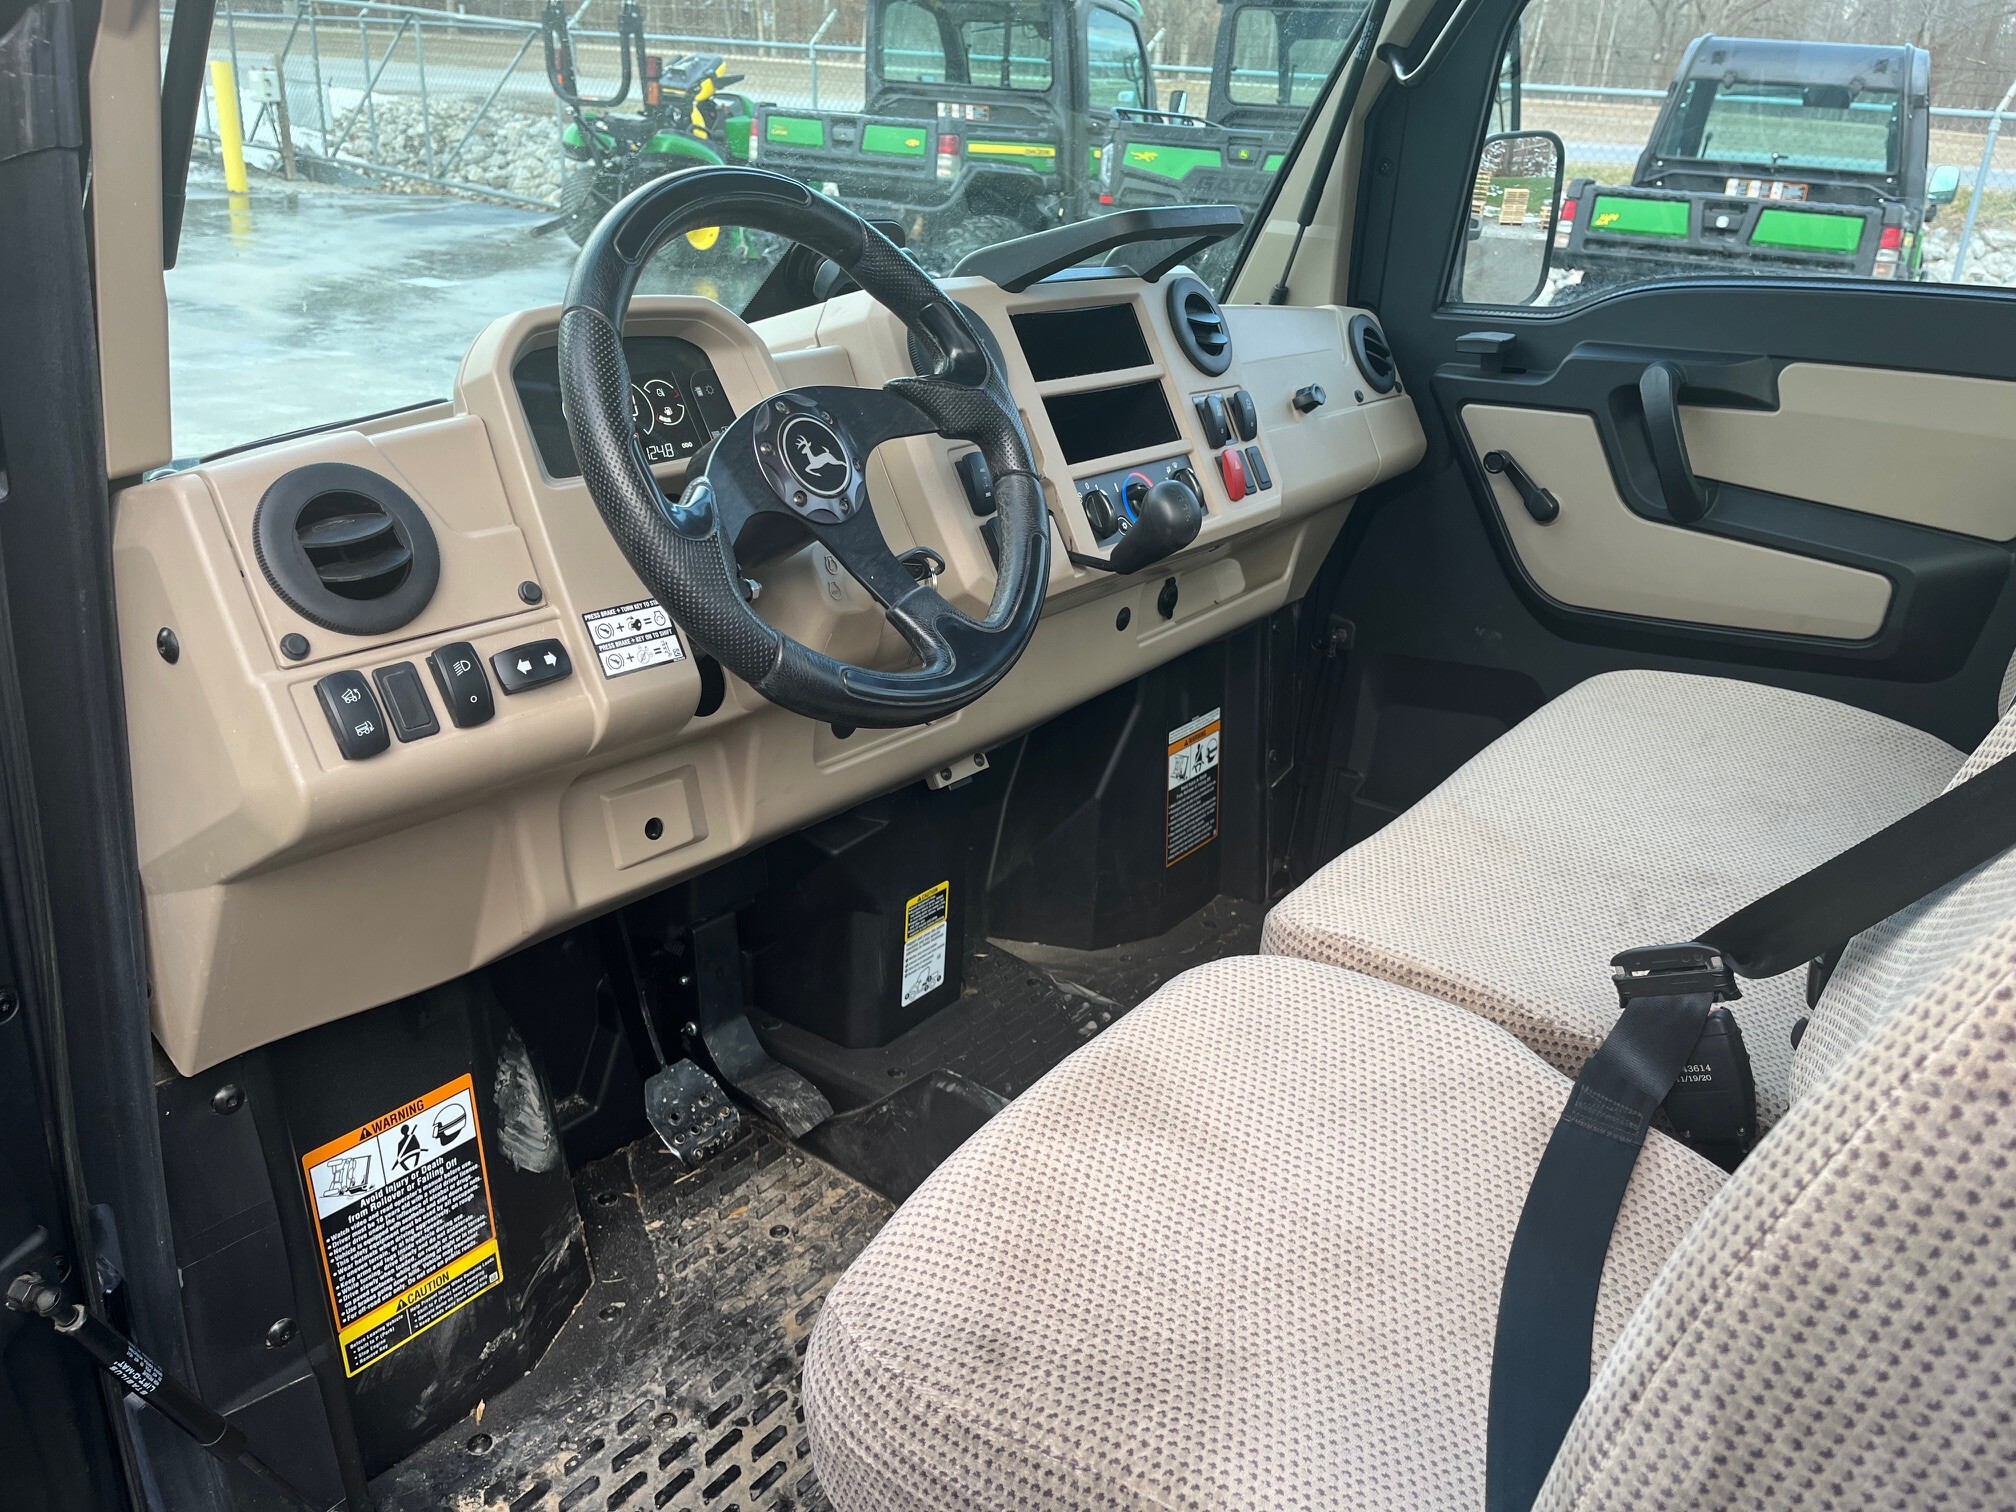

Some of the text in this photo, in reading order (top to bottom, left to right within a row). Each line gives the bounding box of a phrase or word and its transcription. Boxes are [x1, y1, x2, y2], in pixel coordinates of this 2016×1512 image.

[1196, 176, 1264, 195] GATO
[645, 443, 674, 460] 124.8
[584, 612, 600, 620] PRESS
[600, 608, 616, 616] BRAKE
[598, 642, 614, 650] PRESS
[614, 638, 630, 647] BRAKE
[658, 628, 671, 636] SHIFT
[371, 1099, 423, 1133] WARNING
[407, 1271, 449, 1303] CAUTION
